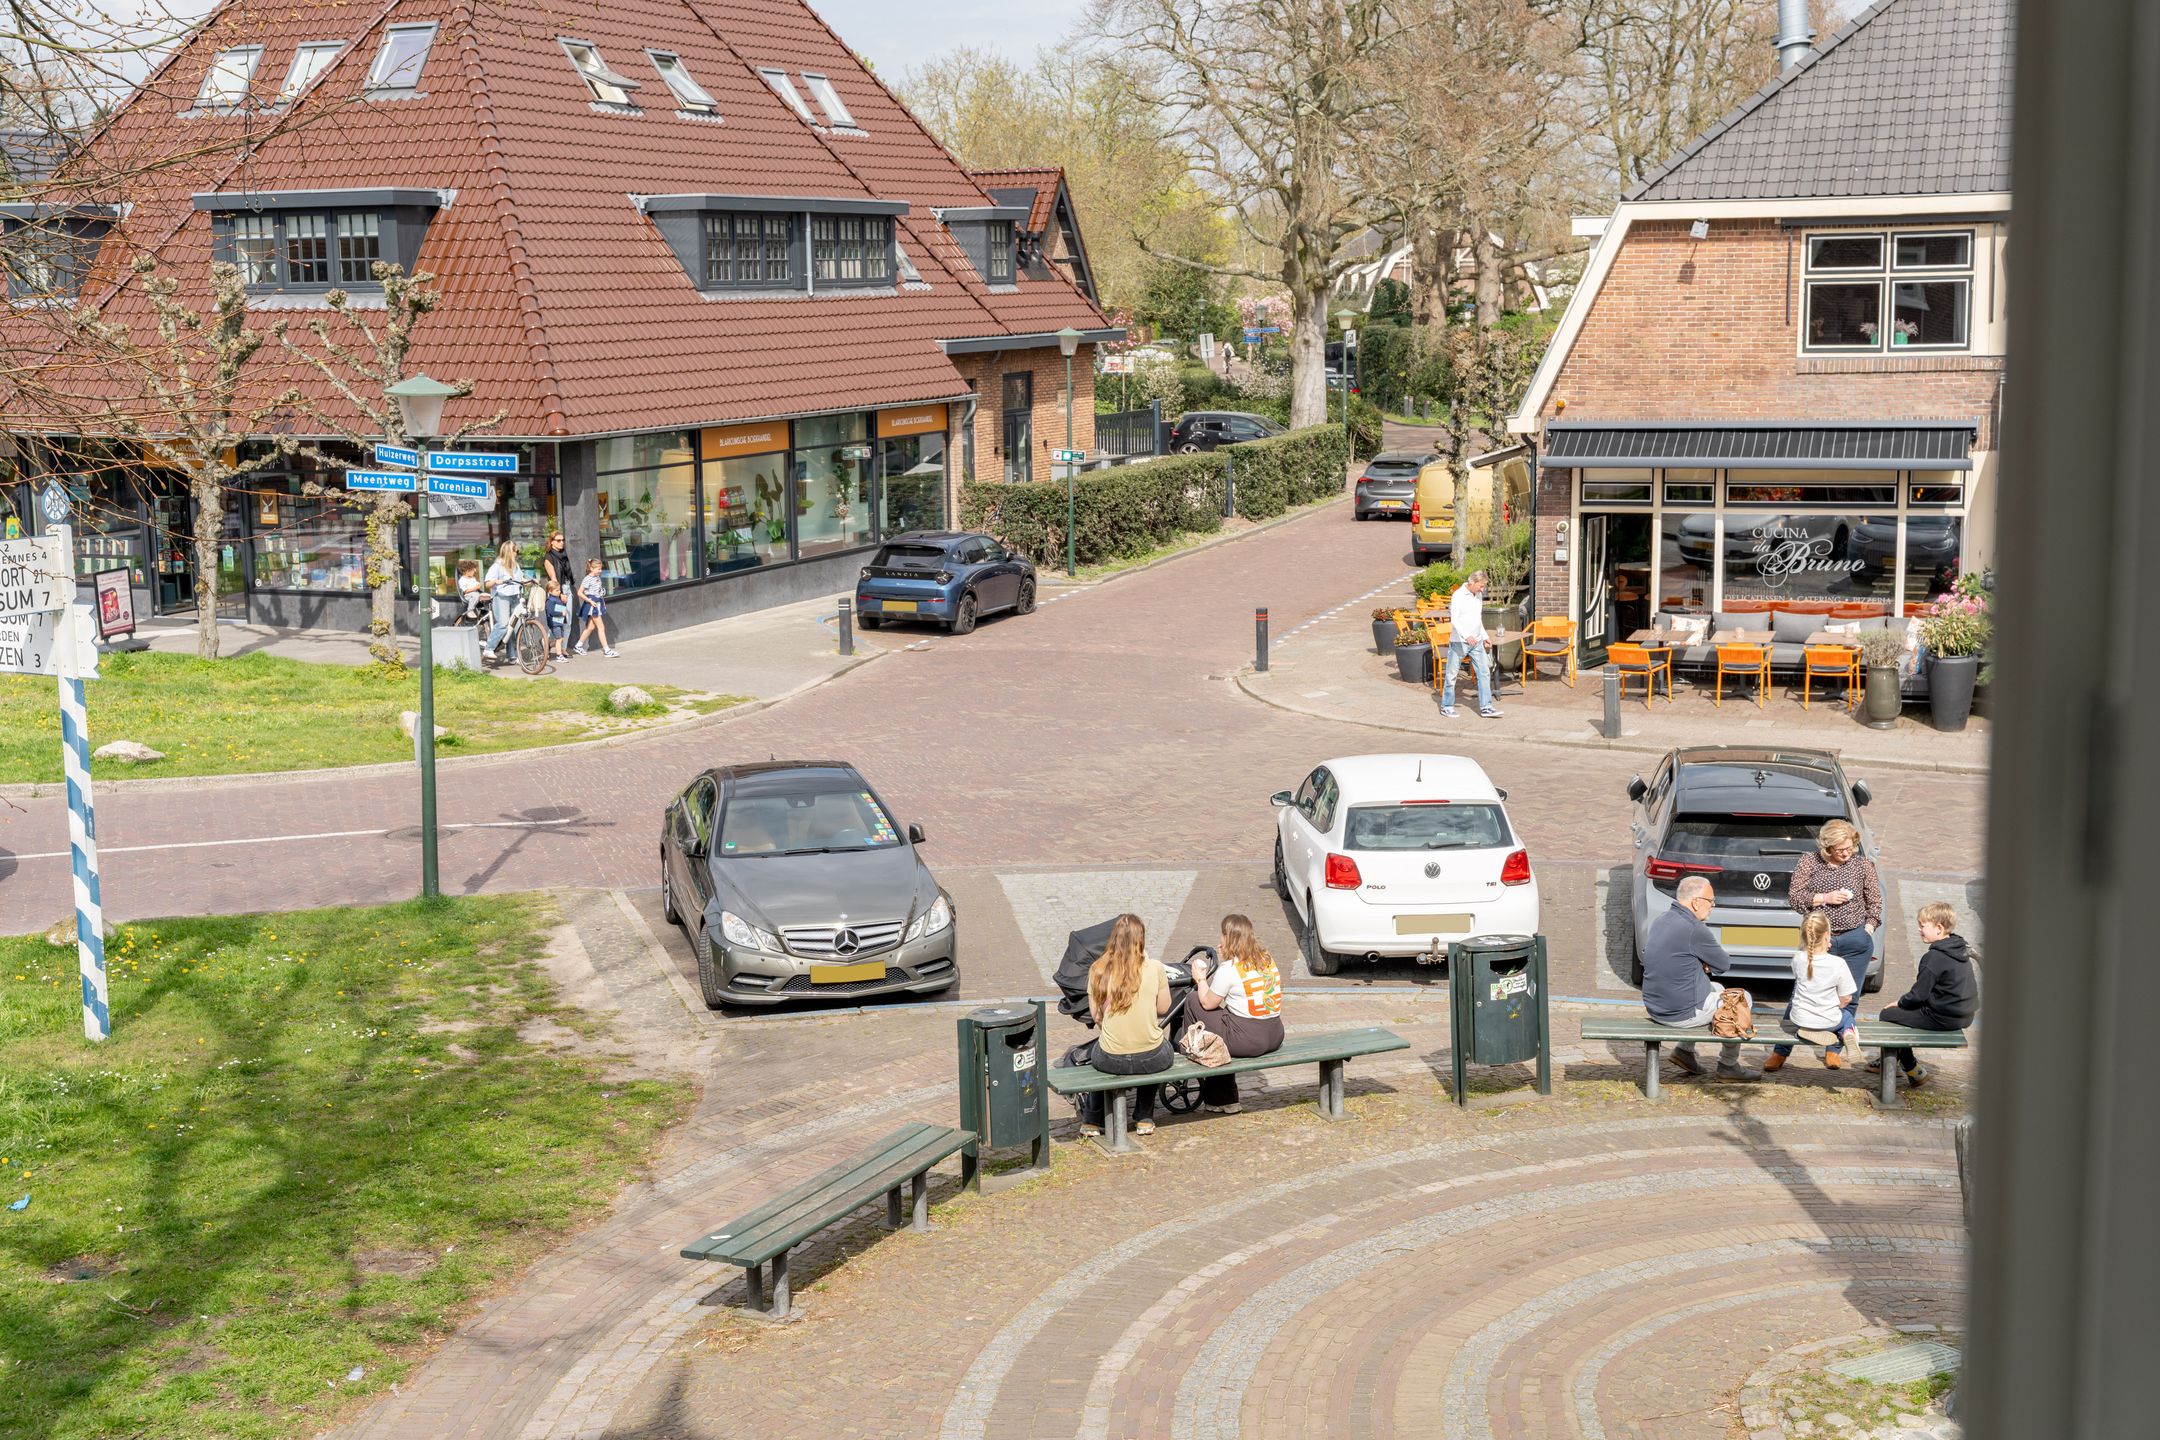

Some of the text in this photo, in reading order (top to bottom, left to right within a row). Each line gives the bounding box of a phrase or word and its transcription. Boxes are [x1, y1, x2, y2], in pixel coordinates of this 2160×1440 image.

[378, 447, 416, 464] Huizerweg
[435, 455, 510, 468] Dorpsstraat
[353, 474, 410, 488] Meentweg
[433, 480, 483, 494] Torenlaan
[1752, 527, 1809, 539] CUCINA
[4, 543, 9, 552] 2
[1752, 539, 1771, 552] da
[41, 551, 47, 560] 4
[1756, 538, 1866, 588] Bruno
[1, 567, 44, 588] ORT 21
[42, 591, 50, 606] 7
[37, 612, 43, 627] 7
[0, 630, 33, 643] DEN 7
[34, 653, 41, 668] 3
